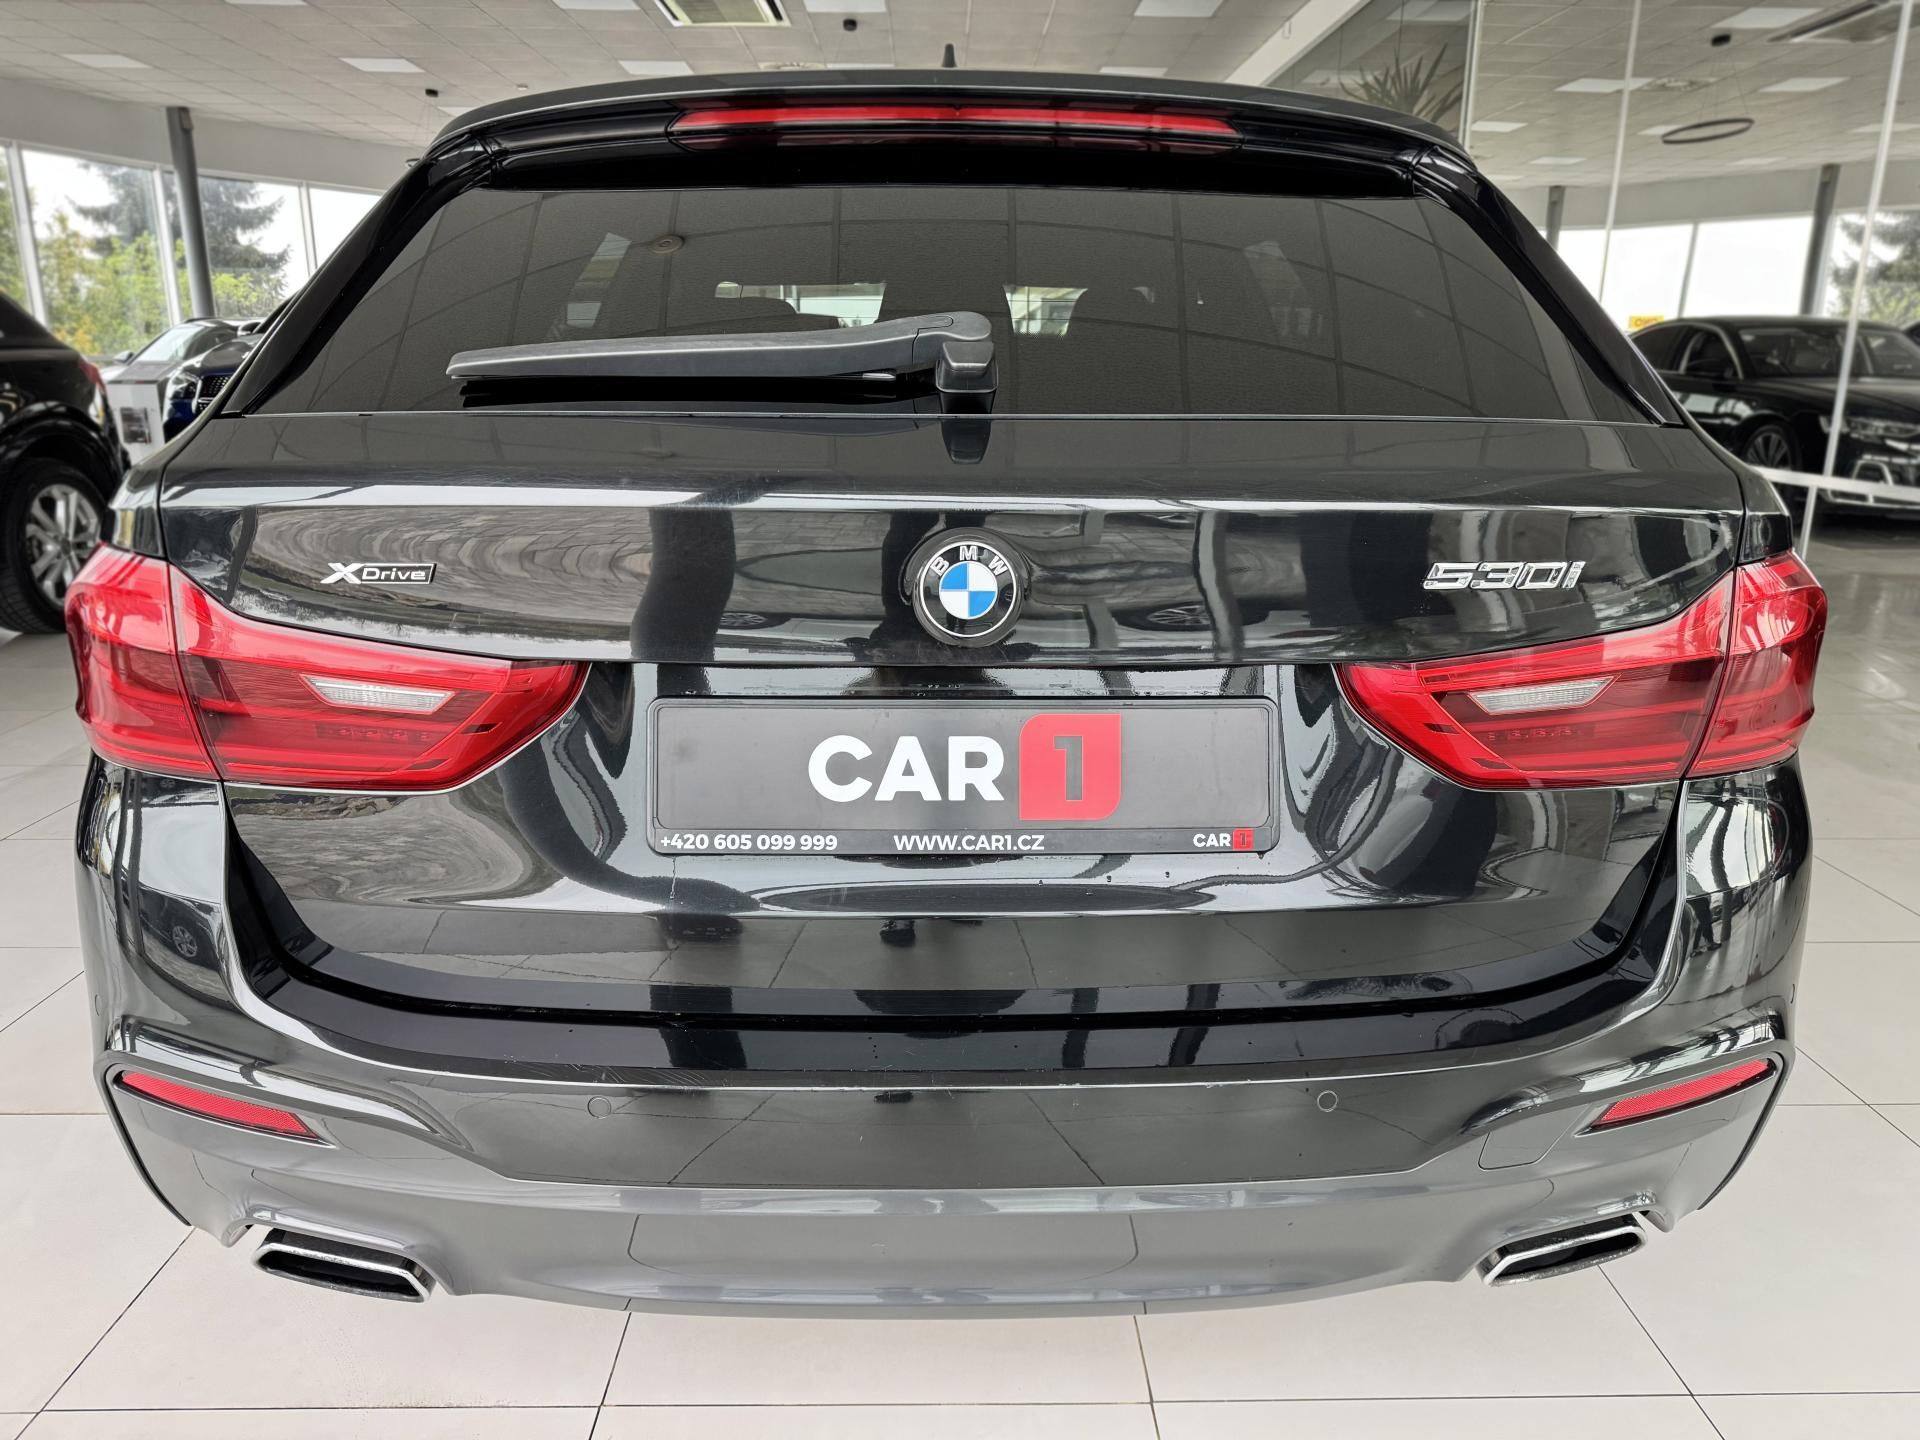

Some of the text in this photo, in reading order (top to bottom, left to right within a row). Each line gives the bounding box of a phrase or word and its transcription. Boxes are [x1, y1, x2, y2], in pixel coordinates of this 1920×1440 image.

[930, 545, 1009, 577] BMW
[1423, 561, 1586, 590] 530i
[660, 833, 838, 851] +420 605 099 999
[893, 834, 1045, 851] WWW.CAR1.CZ
